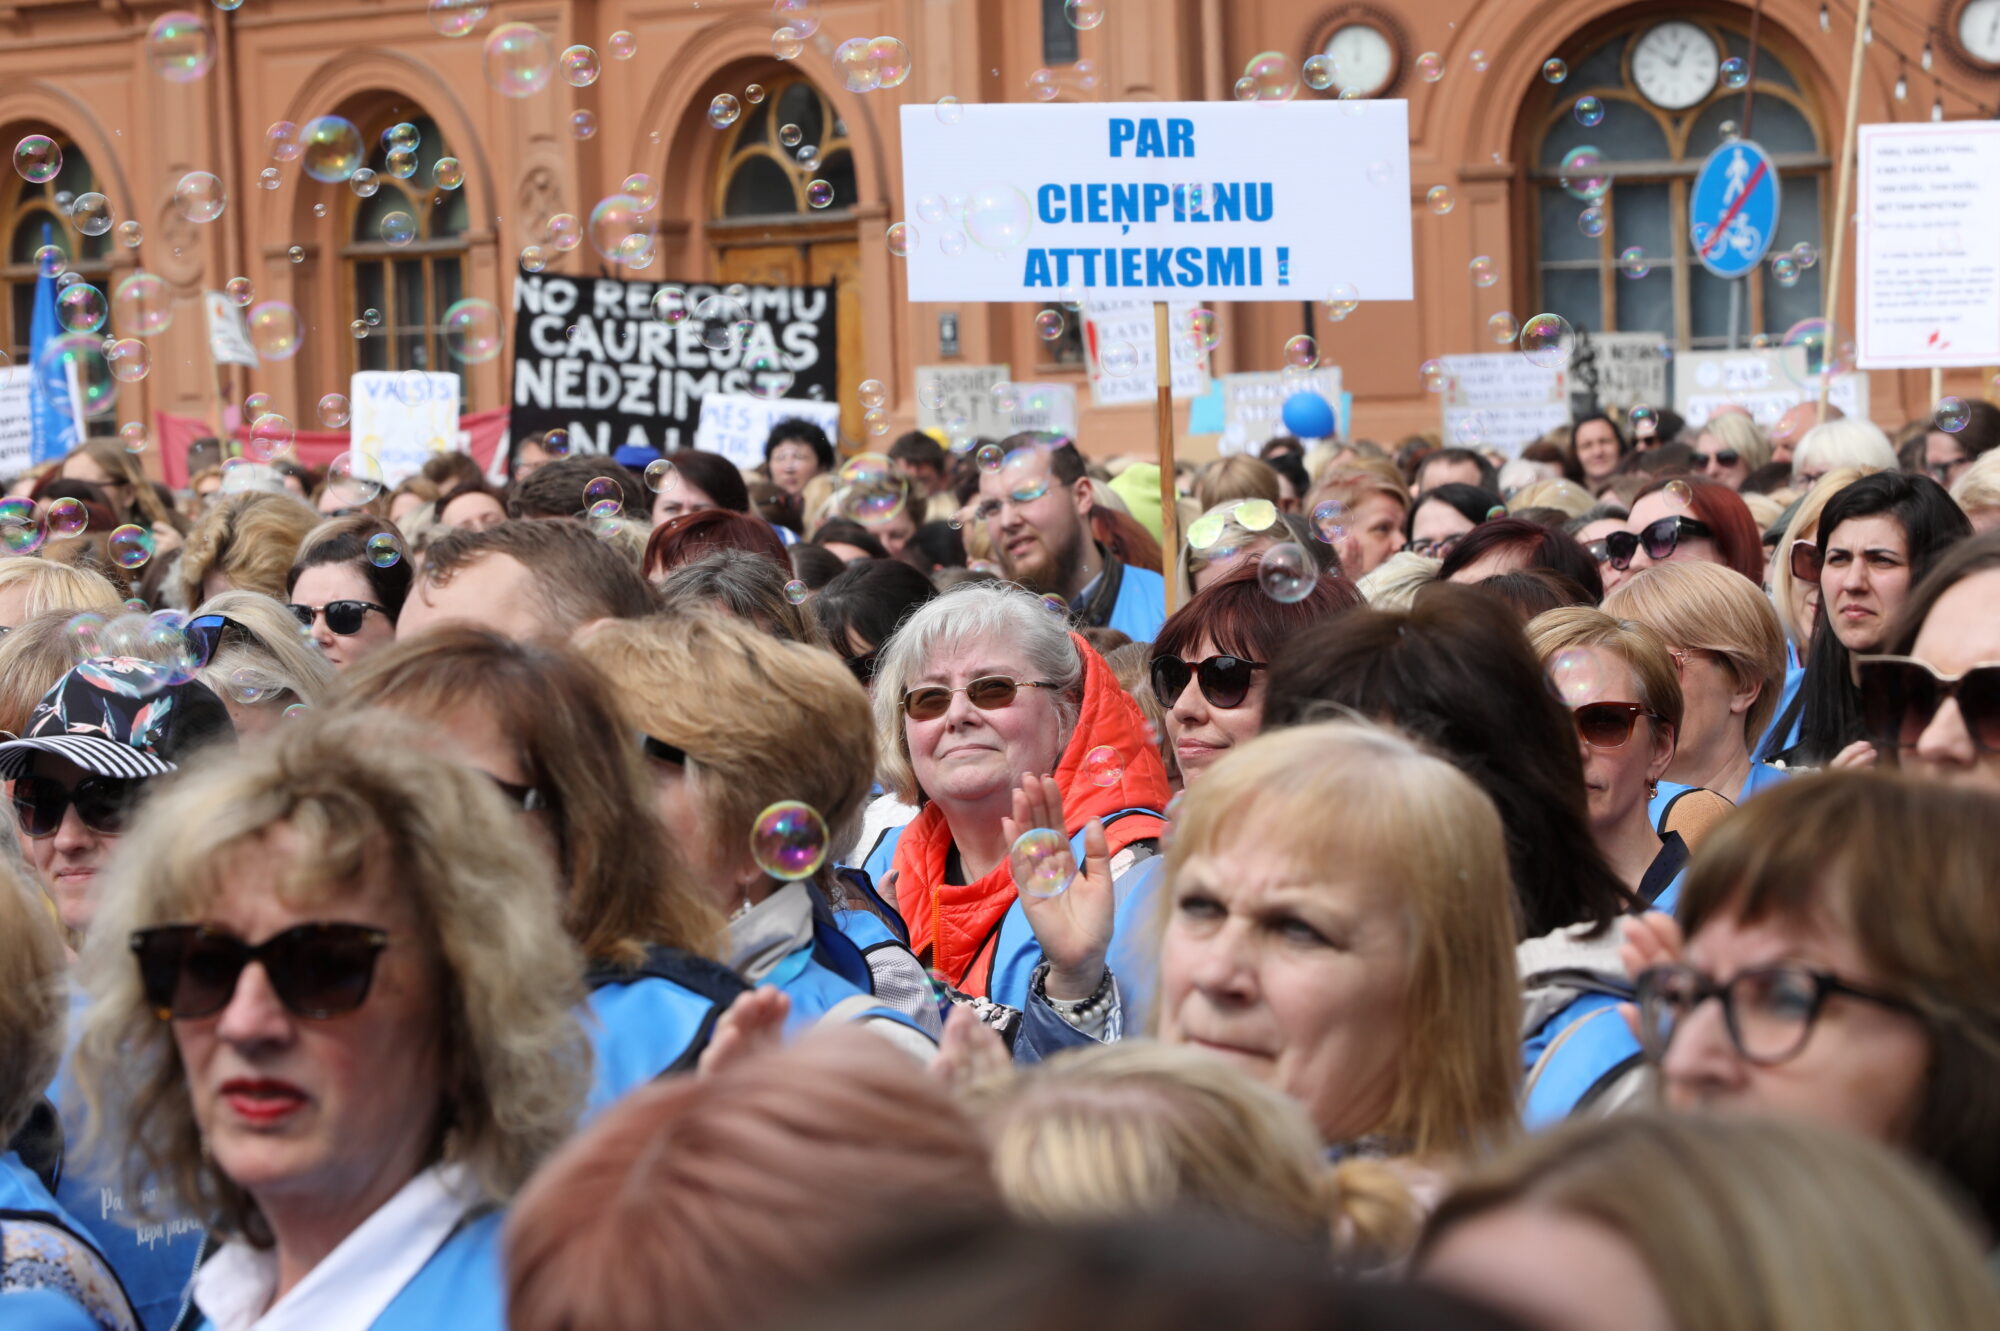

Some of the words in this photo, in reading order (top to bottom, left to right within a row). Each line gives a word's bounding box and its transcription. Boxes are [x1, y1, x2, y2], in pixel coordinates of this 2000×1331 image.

[1109, 118, 1195, 158] PAR
[1037, 182, 1273, 236] CIEŅPILNU
[1023, 247, 1262, 288] ATTIEKSMI
[513, 275, 579, 316] NO
[593, 278, 827, 323] REFORMU
[529, 314, 821, 371] CAUREJAS
